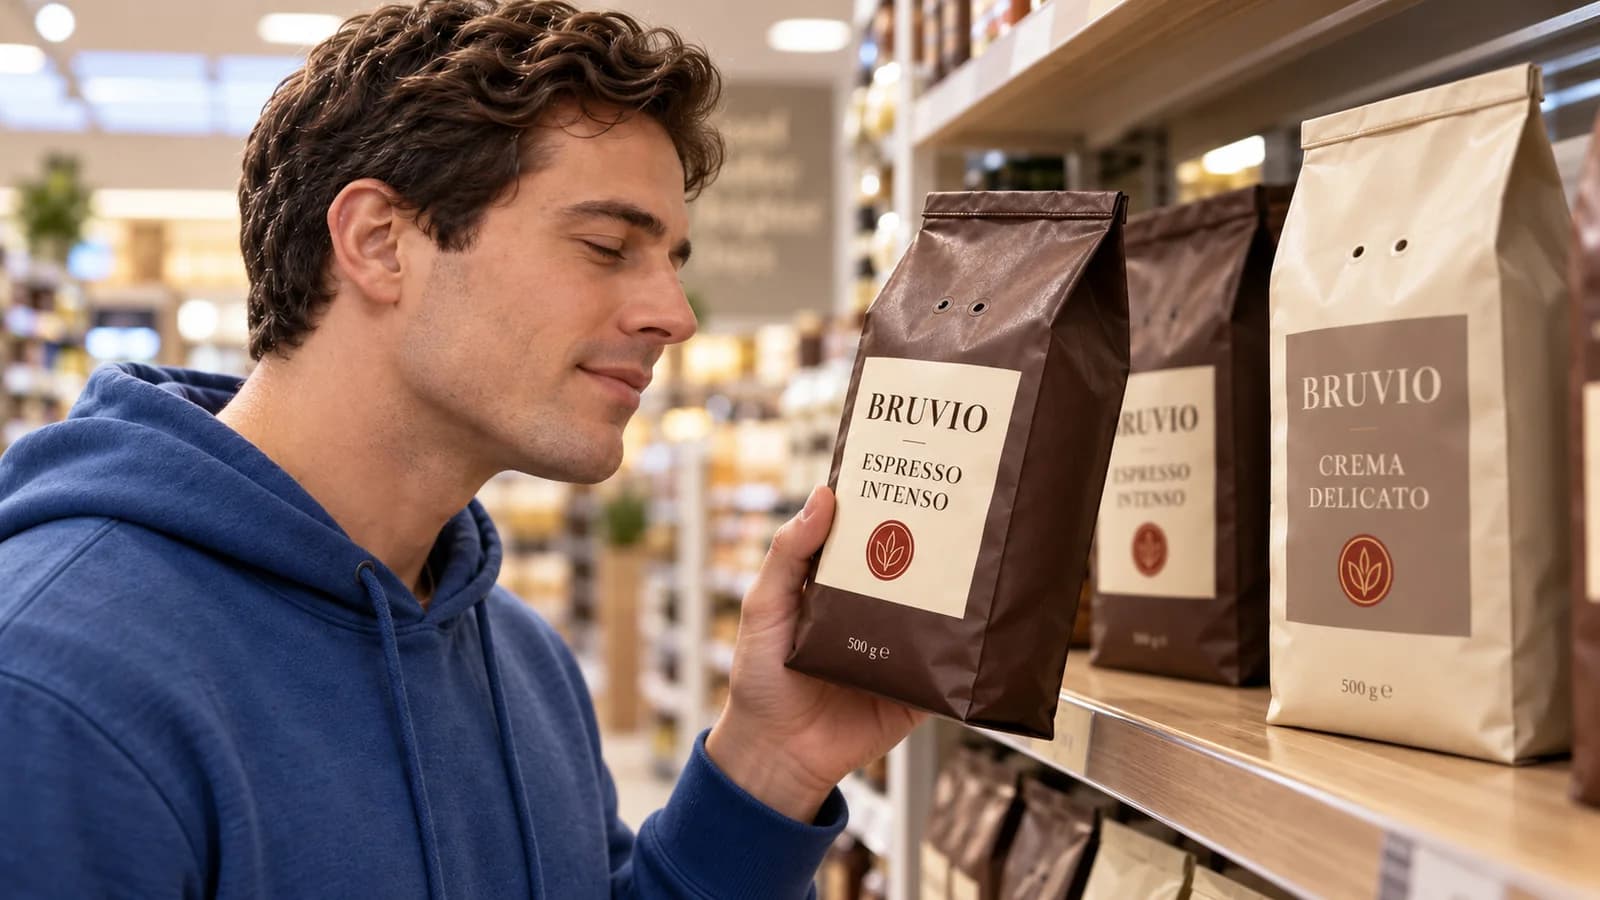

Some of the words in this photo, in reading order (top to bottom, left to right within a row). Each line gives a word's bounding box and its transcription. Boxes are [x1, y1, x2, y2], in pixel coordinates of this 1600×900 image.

[1302, 366, 1442, 410] BRUVIO
[867, 392, 988, 433] BRUVIO
[1117, 405, 1199, 437] RUVIO
[862, 453, 963, 485] ESPRESSO
[1113, 463, 1191, 484] ESPRESSO
[1319, 453, 1406, 477] CREMA
[860, 480, 949, 512] INTENSO
[1117, 489, 1187, 508] INTENSO
[1308, 486, 1430, 510] DELICATO
[847, 636, 868, 653] 500
[1341, 678, 1366, 695] 500
